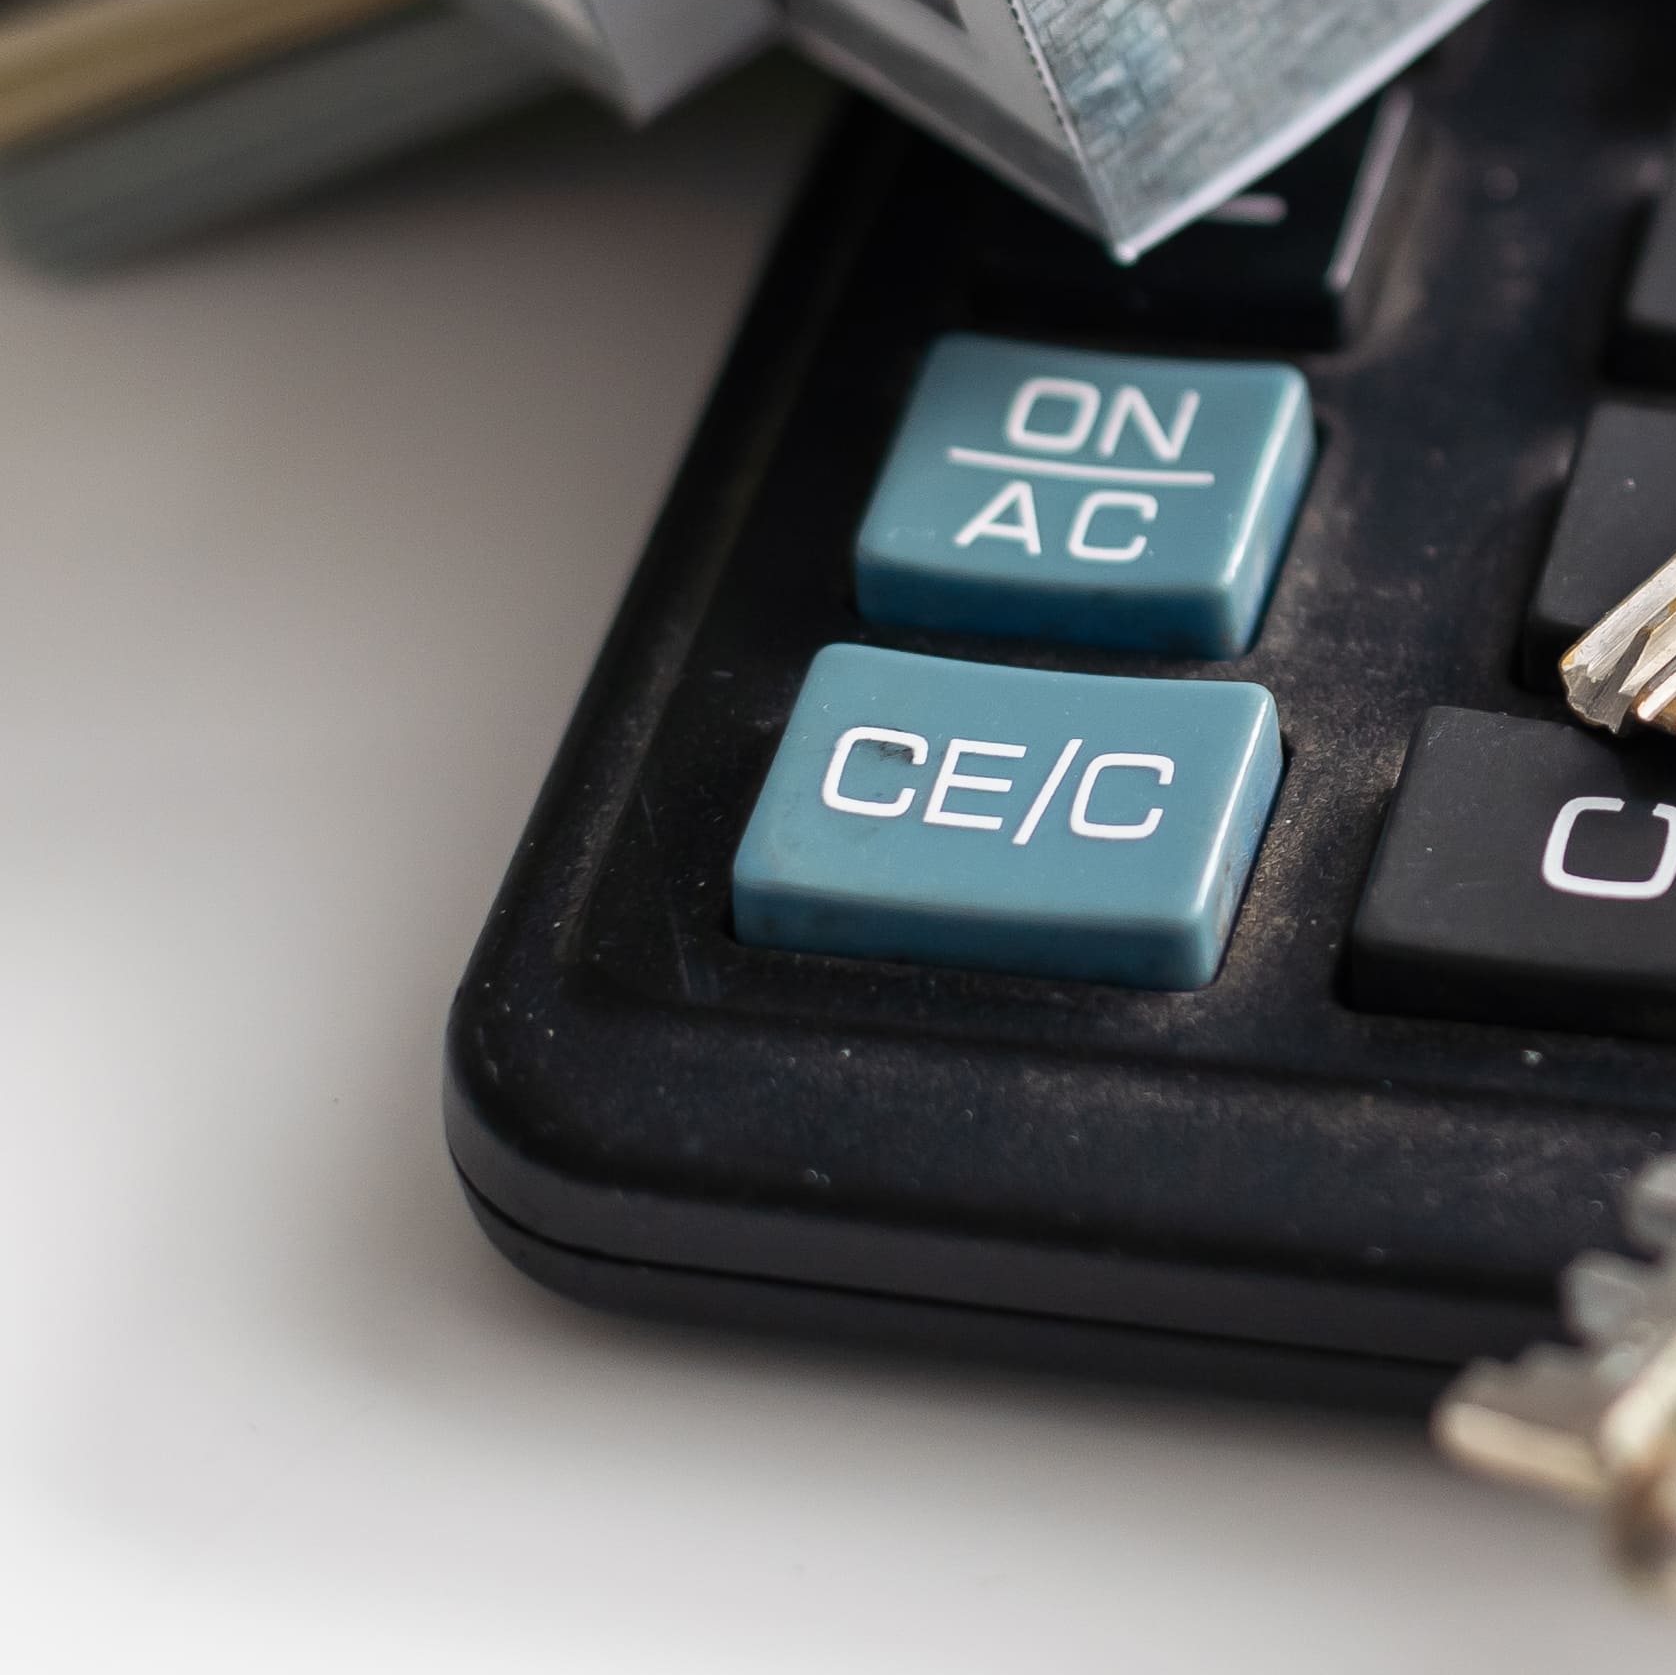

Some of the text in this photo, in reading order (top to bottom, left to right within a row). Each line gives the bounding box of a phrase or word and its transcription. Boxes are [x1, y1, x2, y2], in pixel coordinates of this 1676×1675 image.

[1003, 377, 1201, 462] ON
[954, 481, 1159, 563] AC
[820, 724, 1176, 846] CE/C
